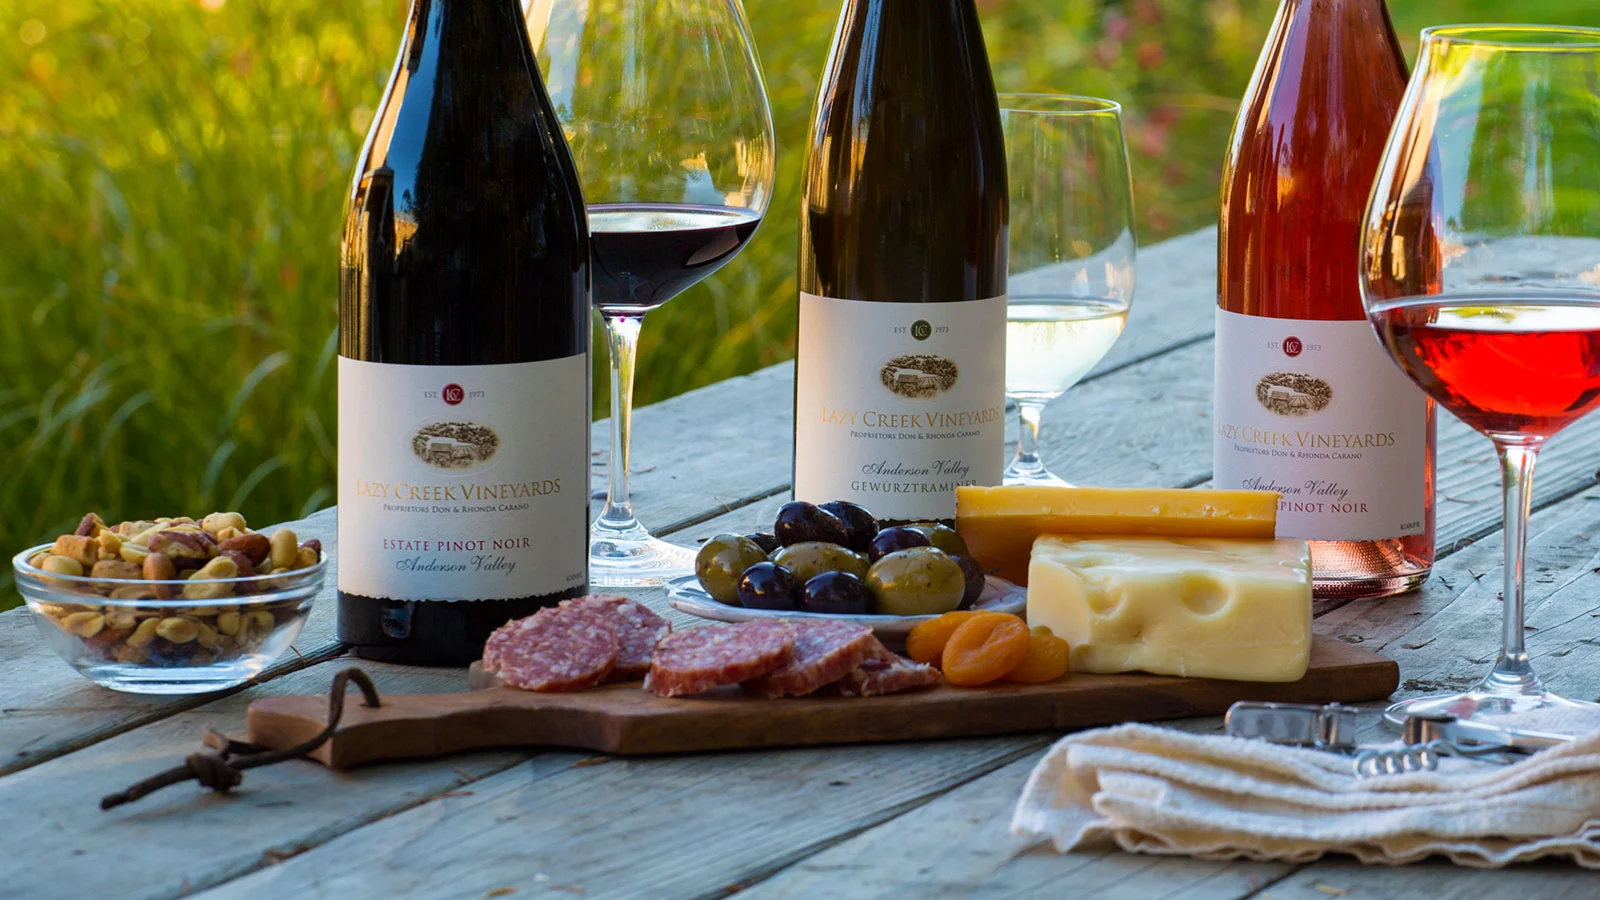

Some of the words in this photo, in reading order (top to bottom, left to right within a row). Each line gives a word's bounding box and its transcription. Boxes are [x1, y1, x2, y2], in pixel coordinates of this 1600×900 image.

[469, 390, 485, 399] 1973
[821, 406, 858, 425] LAZY
[862, 410, 923, 429] CREEK
[924, 406, 1000, 428] VINEYARDS
[850, 430, 896, 440] PROPRIETORS
[898, 432, 917, 440] DON
[925, 432, 956, 440] RHONDA
[956, 430, 981, 439] CARANO
[1241, 425, 1293, 446] CREEK
[1295, 431, 1396, 448] VINEYARDS
[1234, 444, 1270, 456] PROPRIETORS
[1271, 449, 1288, 457] DON
[1297, 451, 1330, 459] RHONDA
[1332, 452, 1363, 460] CARANO
[862, 460, 930, 476] Anderson
[931, 459, 971, 479] Valley
[355, 477, 391, 498] LAZY
[394, 482, 458, 501] CREEK
[459, 478, 562, 501] VINEYARDS
[1241, 476, 1302, 495] Anderson
[1303, 479, 1350, 501] Valley
[383, 503, 430, 514] PROPRIETORS
[431, 505, 451, 513] DON
[461, 505, 497, 513] RHONDA
[498, 503, 530, 512] CARANO
[1279, 501, 1325, 513] PINOT
[1330, 502, 1369, 513] NOIR
[383, 538, 430, 551] ESTATE
[437, 540, 487, 551] PINOT
[492, 537, 532, 550] NOIR
[395, 555, 467, 573] Anderson
[469, 554, 516, 577] Valley
